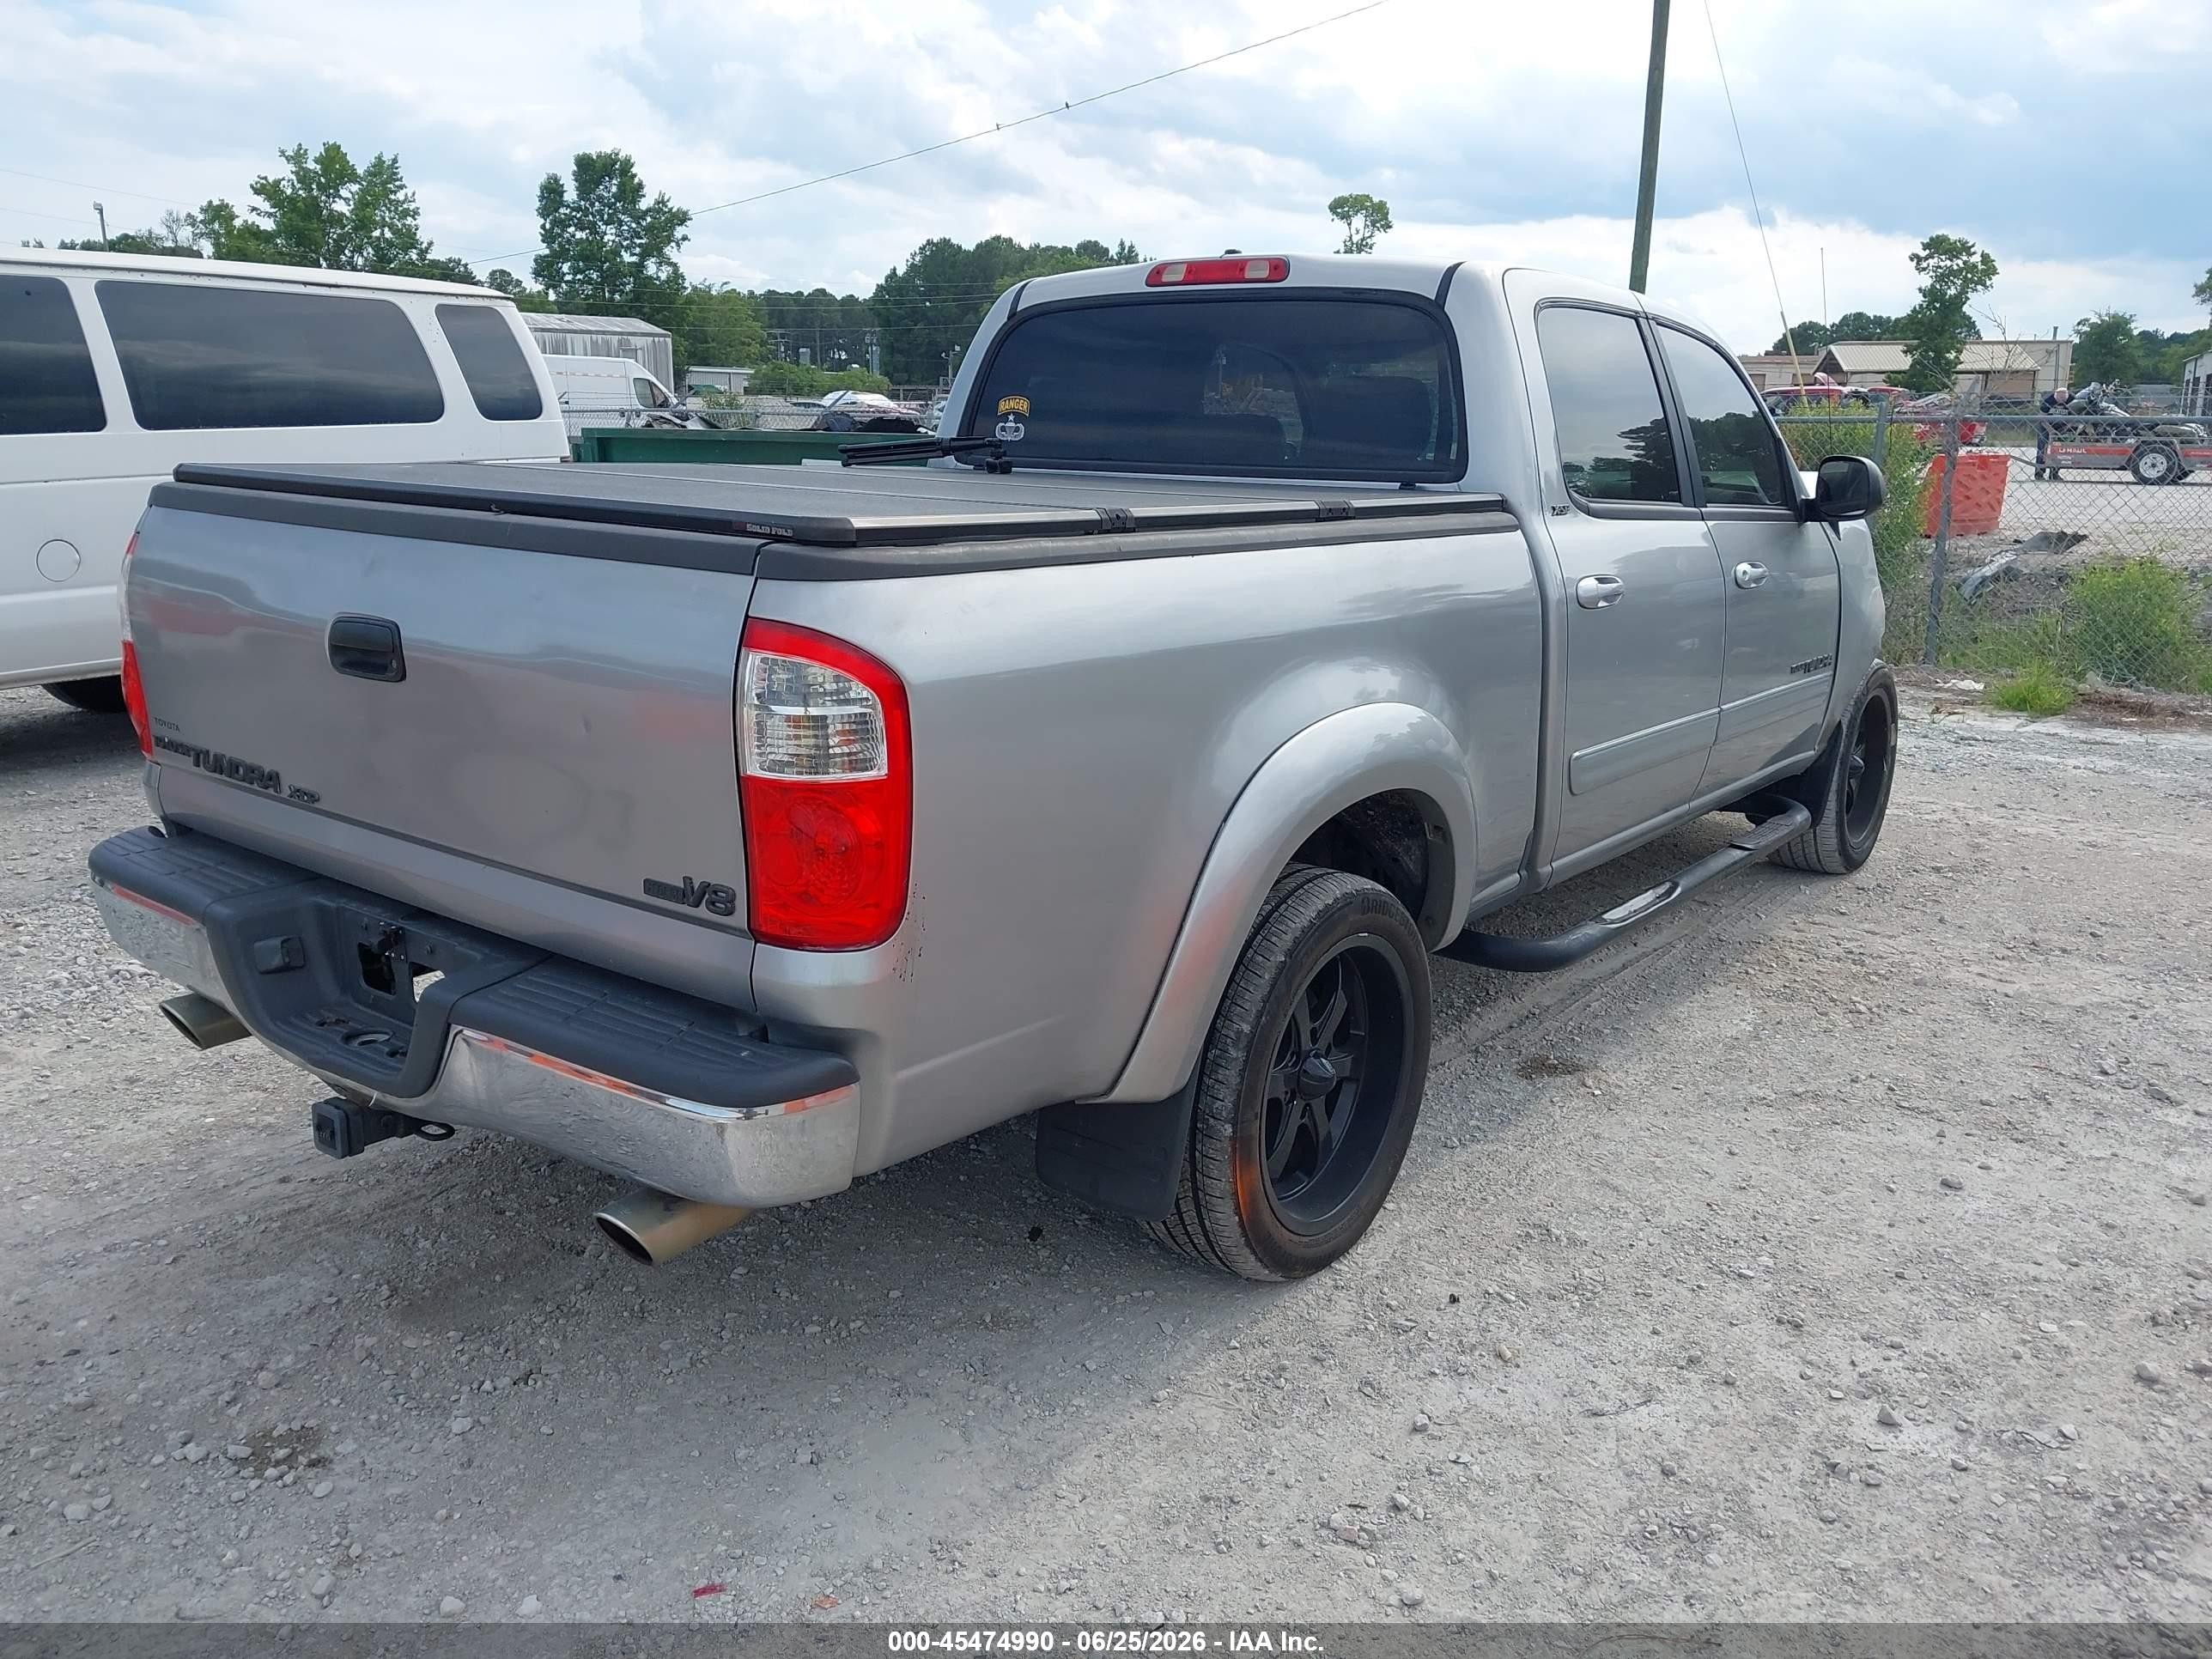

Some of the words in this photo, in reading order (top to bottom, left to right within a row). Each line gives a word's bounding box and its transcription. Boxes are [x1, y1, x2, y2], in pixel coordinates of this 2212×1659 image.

[1000, 398, 1028, 413] RANGER
[746, 523, 770, 534] SOLID
[771, 526, 793, 537] FOLD
[154, 716, 180, 732] TOYOTA
[191, 748, 282, 795] TUNDRA
[683, 875, 737, 917] V8
